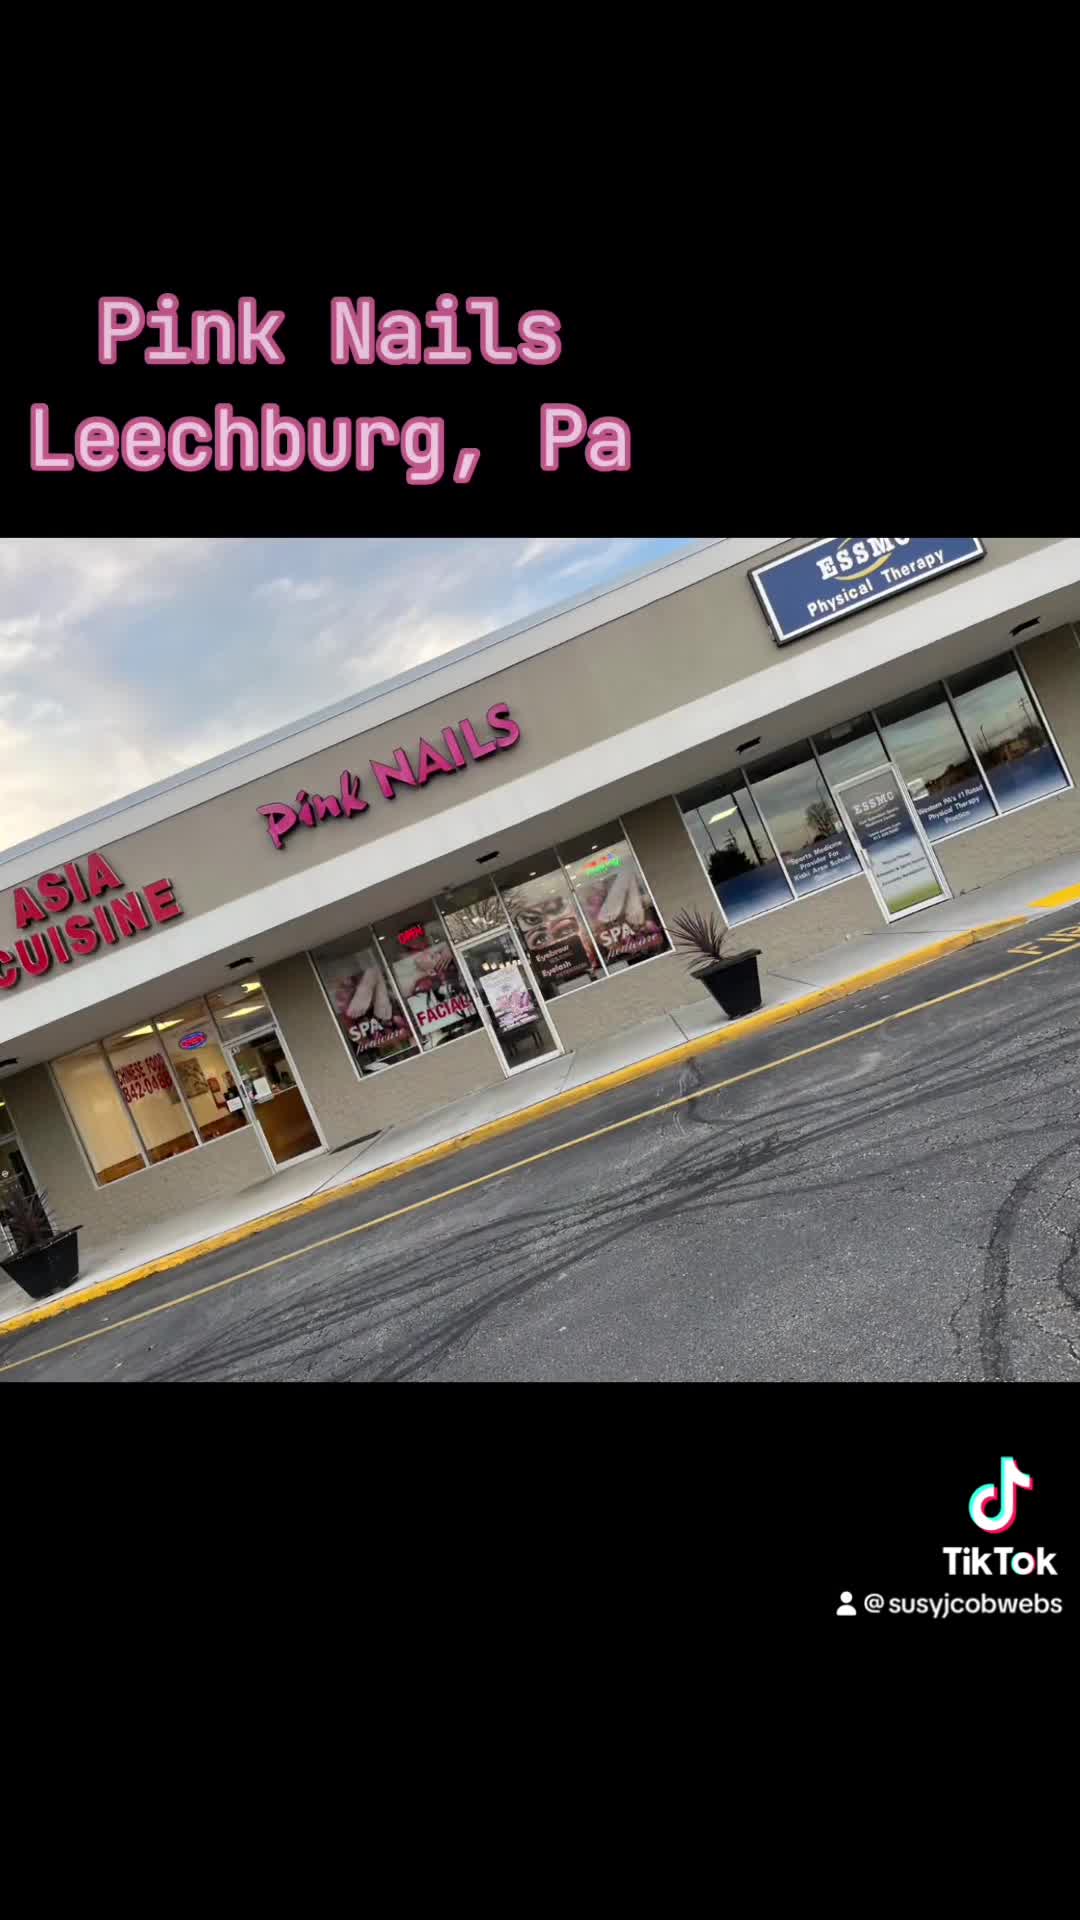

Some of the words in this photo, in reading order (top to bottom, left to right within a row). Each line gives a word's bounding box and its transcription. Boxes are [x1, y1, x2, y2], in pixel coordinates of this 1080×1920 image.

[807, 578, 873, 617] Physical
[880, 549, 944, 584] Therapy
[256, 769, 370, 850] Pink
[369, 702, 521, 799] NAILS
[853, 791, 895, 815] ESSMC
[927, 805, 953, 820] Physical
[954, 796, 980, 810] Therapy
[827, 850, 840, 859] For
[14, 852, 124, 929] ASIA
[600, 922, 636, 948] SPA
[541, 960, 572, 977] Eyelash
[349, 1018, 384, 1042] SPA
